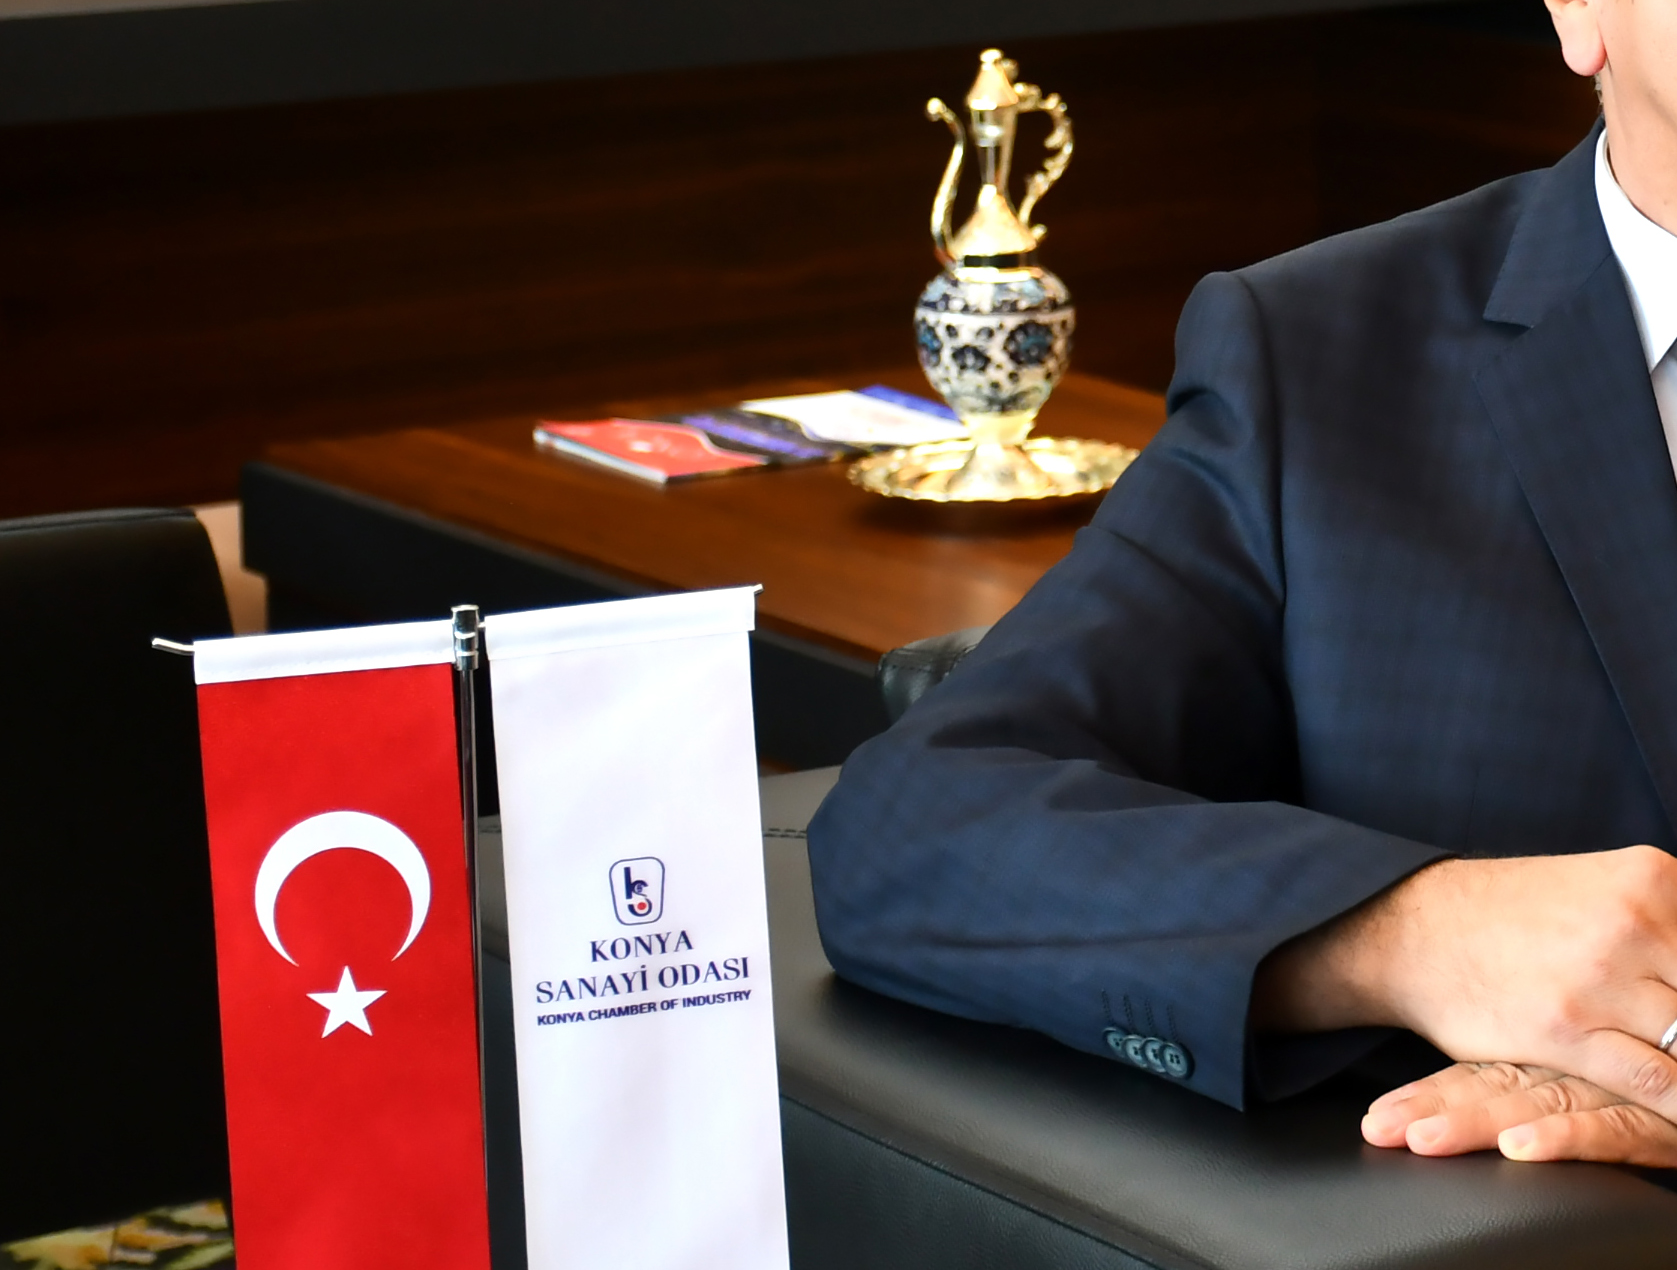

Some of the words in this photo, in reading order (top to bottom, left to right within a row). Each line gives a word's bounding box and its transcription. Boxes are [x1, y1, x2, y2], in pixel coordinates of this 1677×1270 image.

[590, 930, 694, 963] KONYA
[535, 965, 649, 1004] SANAYİ
[658, 956, 750, 989] ODASI
[537, 1009, 585, 1026] KONYA
[588, 1001, 658, 1021] CHAMBER
[660, 998, 679, 1011] OF
[682, 989, 752, 1008] INDUSTRY
